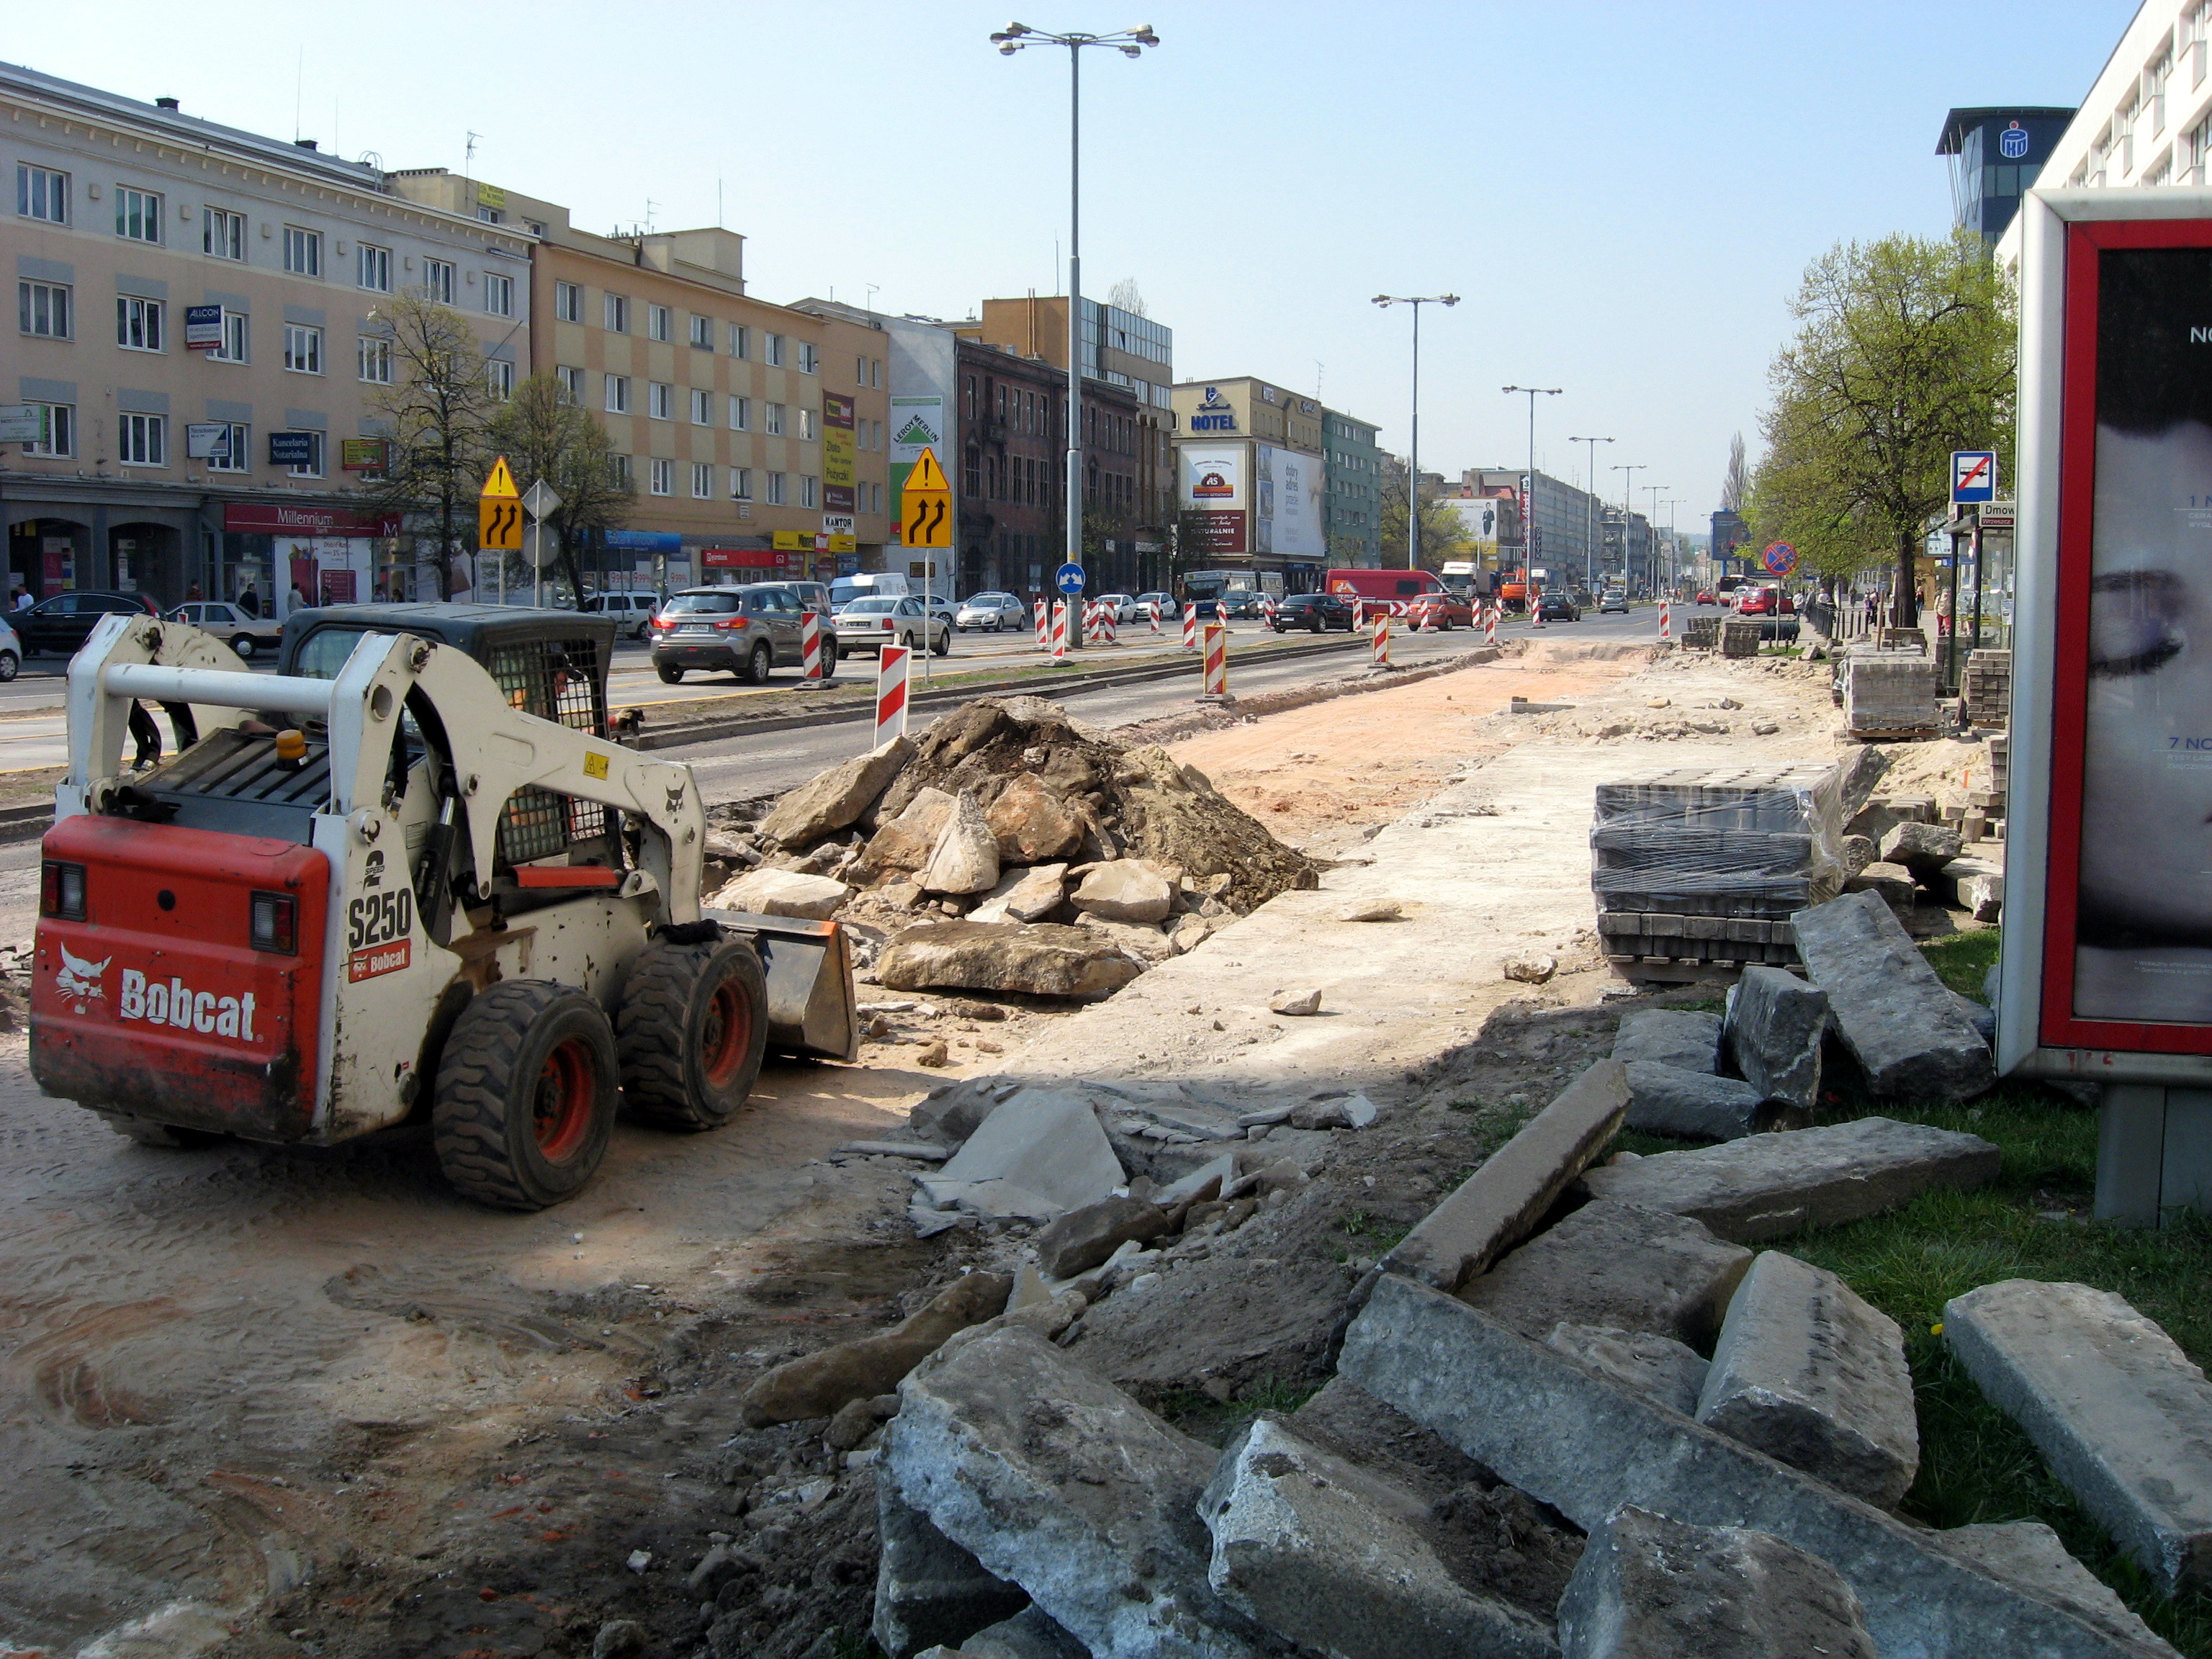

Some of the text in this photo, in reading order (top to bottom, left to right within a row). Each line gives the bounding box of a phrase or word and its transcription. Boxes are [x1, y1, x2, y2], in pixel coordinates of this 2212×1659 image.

[189, 308, 219, 318] ALLCON
[2190, 326, 2212, 343] N
[893, 414, 940, 444] LEROY MERLIN
[1191, 415, 1236, 431] HOTEL
[272, 438, 308, 447] Kancelaria
[273, 450, 308, 459] Notarialna
[1206, 477, 1218, 485] AS
[277, 507, 334, 526] Millennium
[825, 516, 852, 528] KANTOR
[383, 521, 399, 537] M
[2168, 737, 2179, 748] 7
[364, 865, 385, 875] SPEED
[349, 887, 411, 948] S250
[371, 948, 405, 972] Bobcat
[120, 968, 256, 1041] Bobcat
